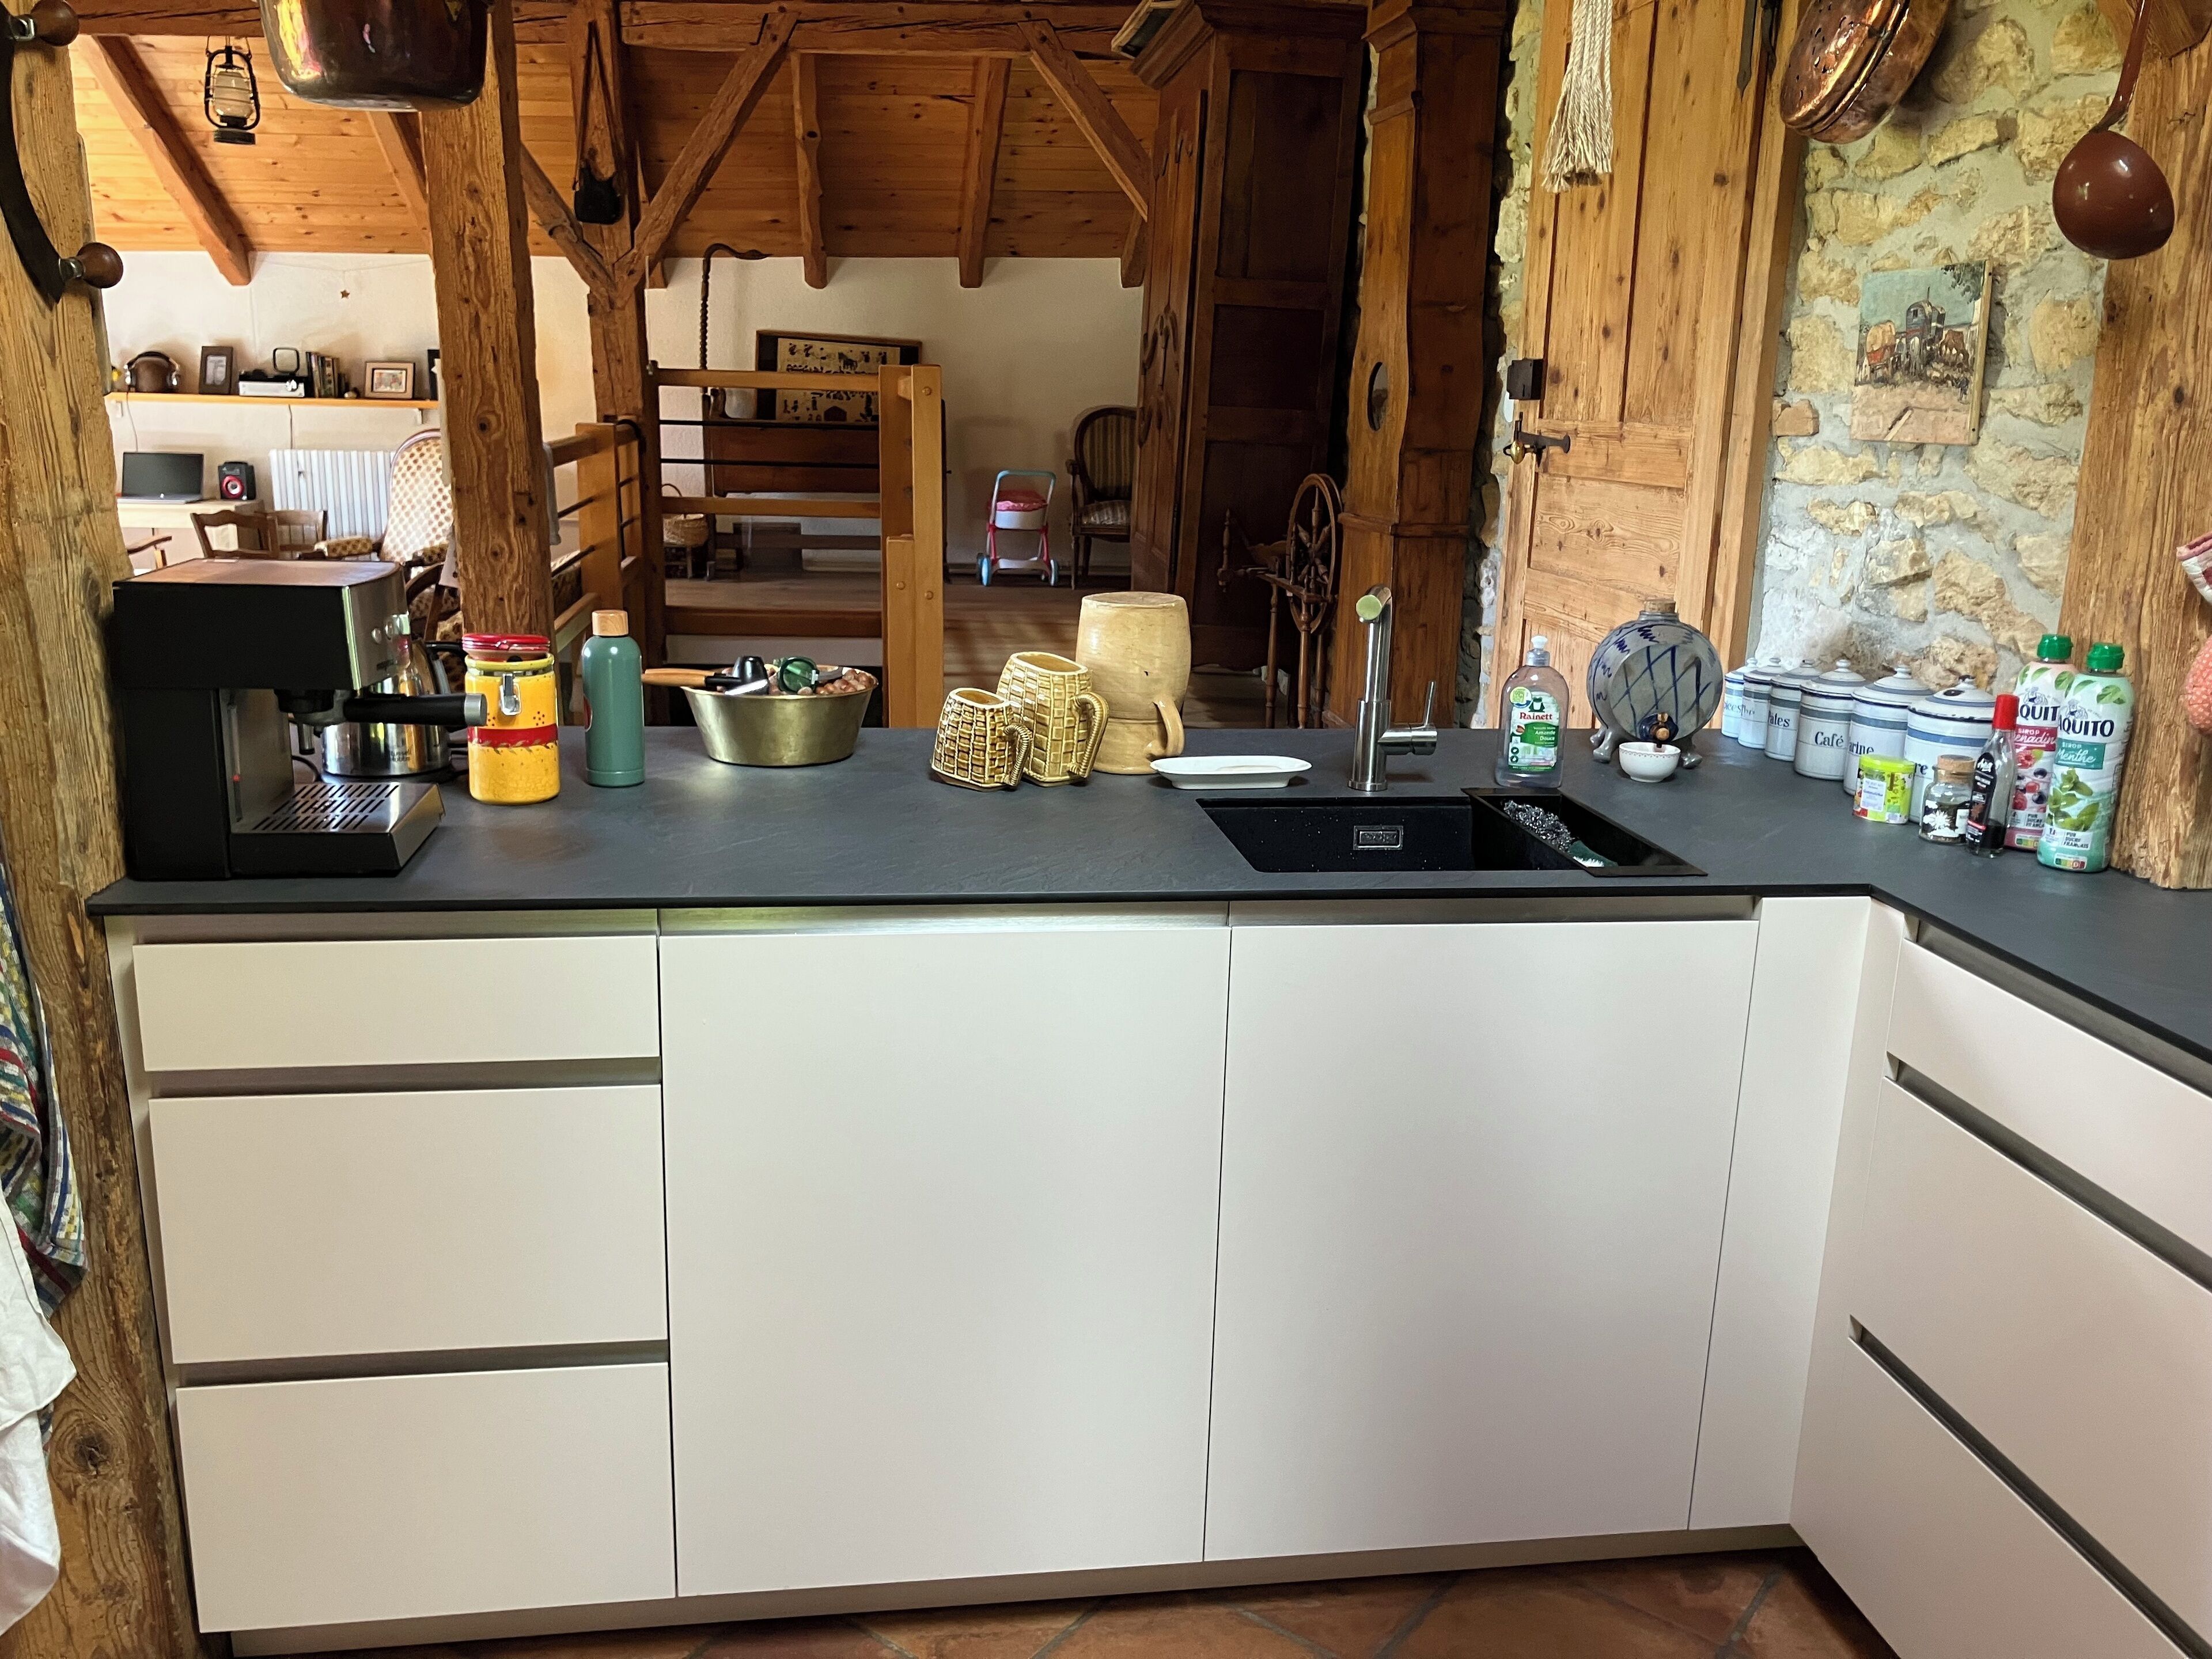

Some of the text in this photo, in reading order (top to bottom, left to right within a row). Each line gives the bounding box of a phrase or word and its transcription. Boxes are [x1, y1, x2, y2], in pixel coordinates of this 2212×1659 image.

[1520, 712, 1553, 720] Rainett
[2020, 704, 2061, 721] QUIT
[2018, 728, 2040, 736] SIROP
[2059, 714, 2115, 738] QUITO
[1814, 730, 1844, 748] Café
[1848, 741, 1874, 755] arine
[2056, 748, 2096, 764] Menthe
